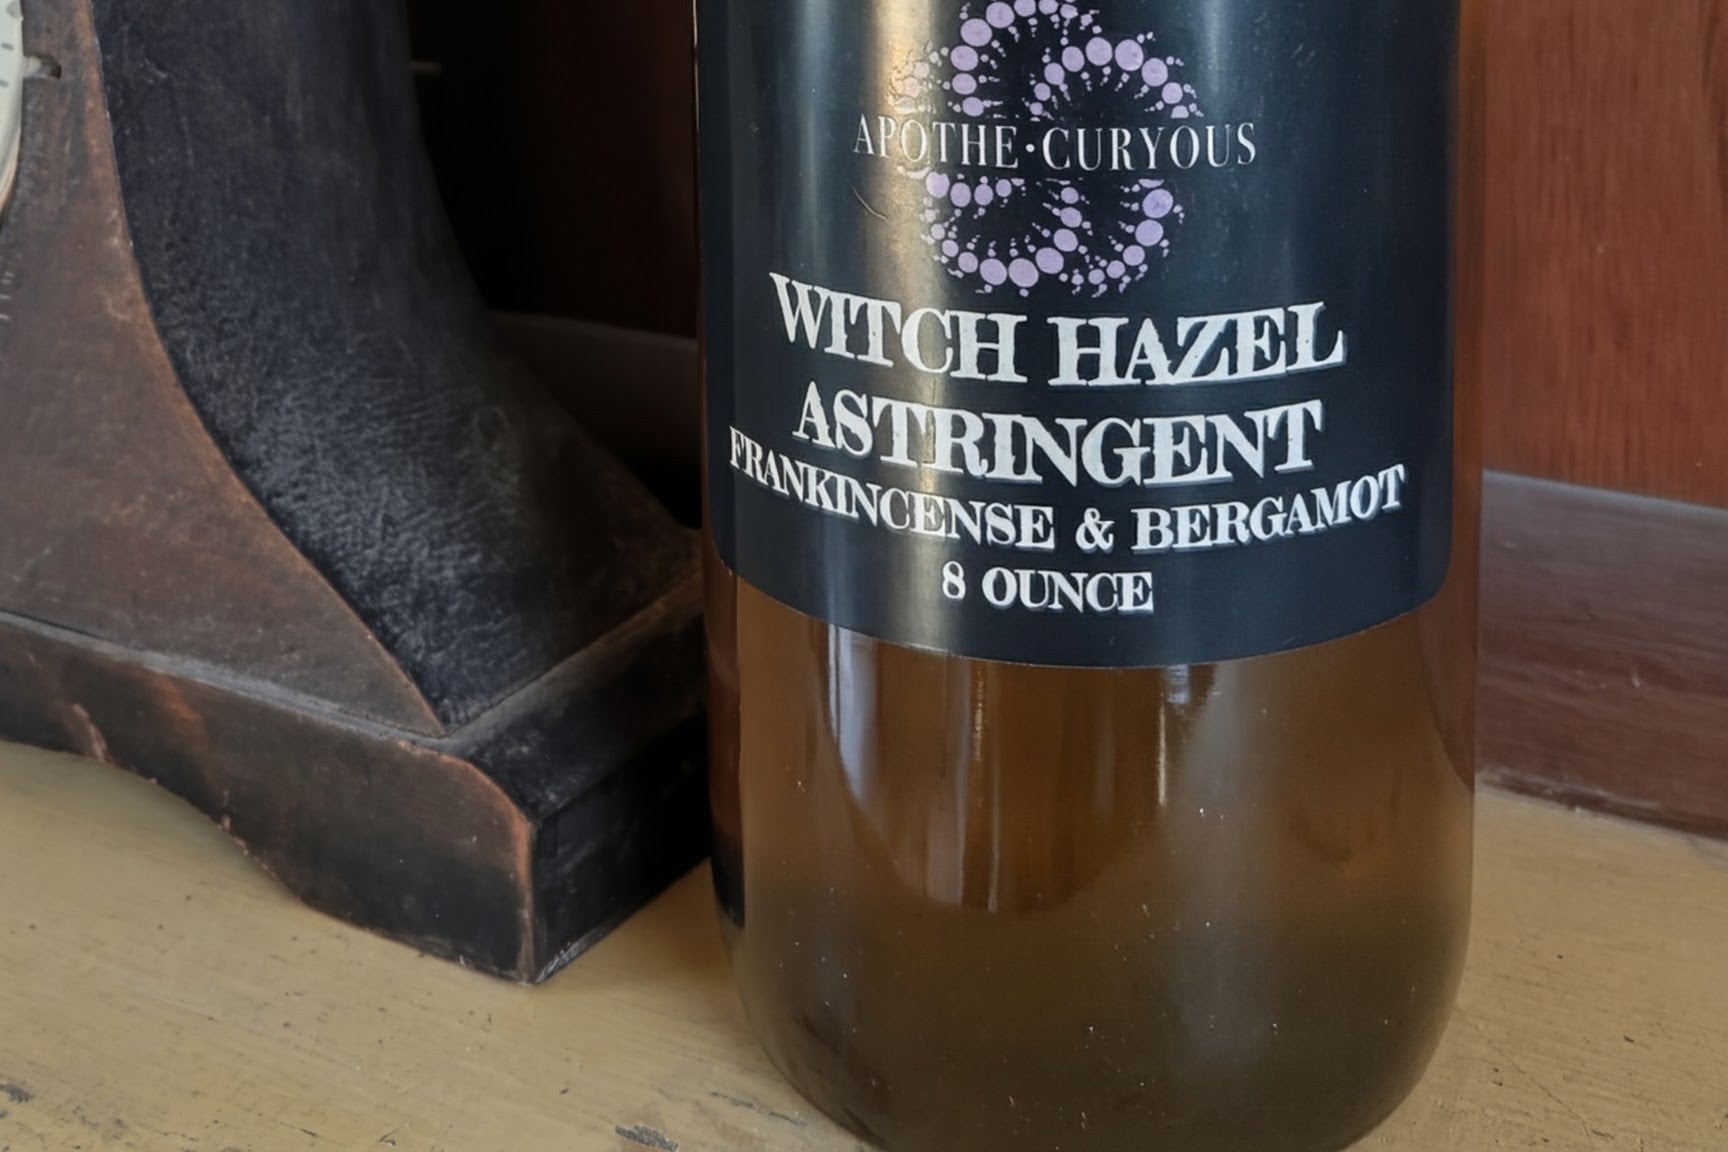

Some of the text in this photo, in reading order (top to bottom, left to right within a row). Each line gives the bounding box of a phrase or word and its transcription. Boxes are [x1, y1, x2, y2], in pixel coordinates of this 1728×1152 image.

[769, 271, 1346, 387] WITCH HAZEL
[729, 425, 1406, 554] FRANKINCENSE & BERGAMOT
[792, 380, 1324, 489] ASTRINGENT
[942, 559, 1154, 614] 8 OUNCE
